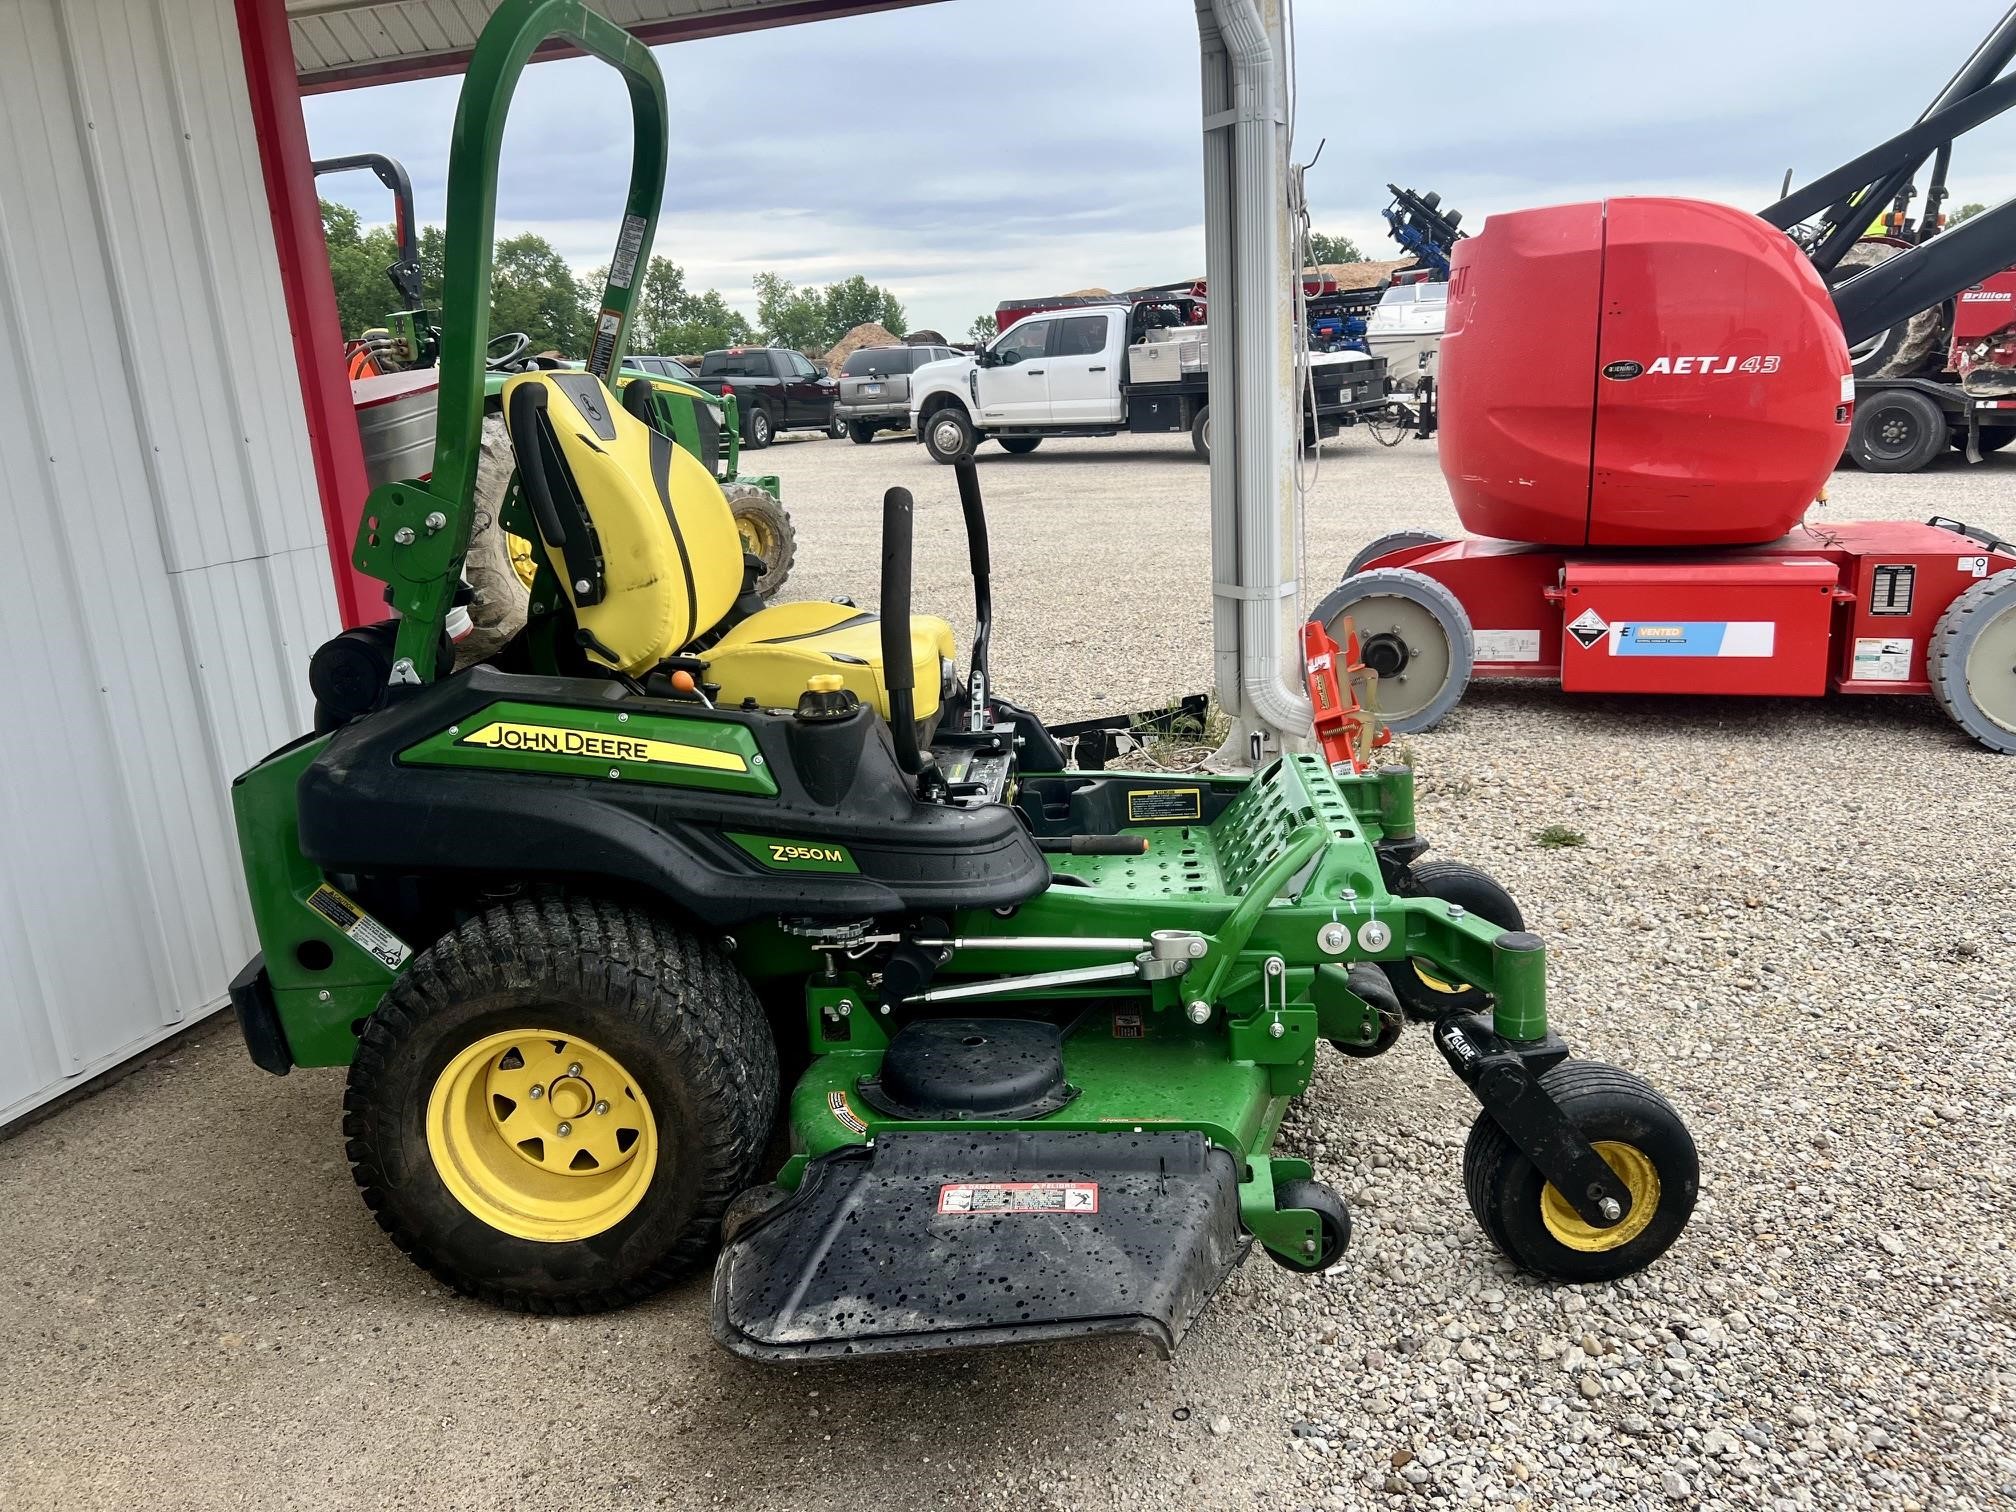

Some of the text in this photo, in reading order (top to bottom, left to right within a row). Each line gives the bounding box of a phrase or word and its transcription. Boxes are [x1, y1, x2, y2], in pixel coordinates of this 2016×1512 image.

[1962, 292, 2011, 301] Brillion
[1646, 355, 1781, 375] AETJ 43
[489, 726, 648, 759] JOHN DEERE
